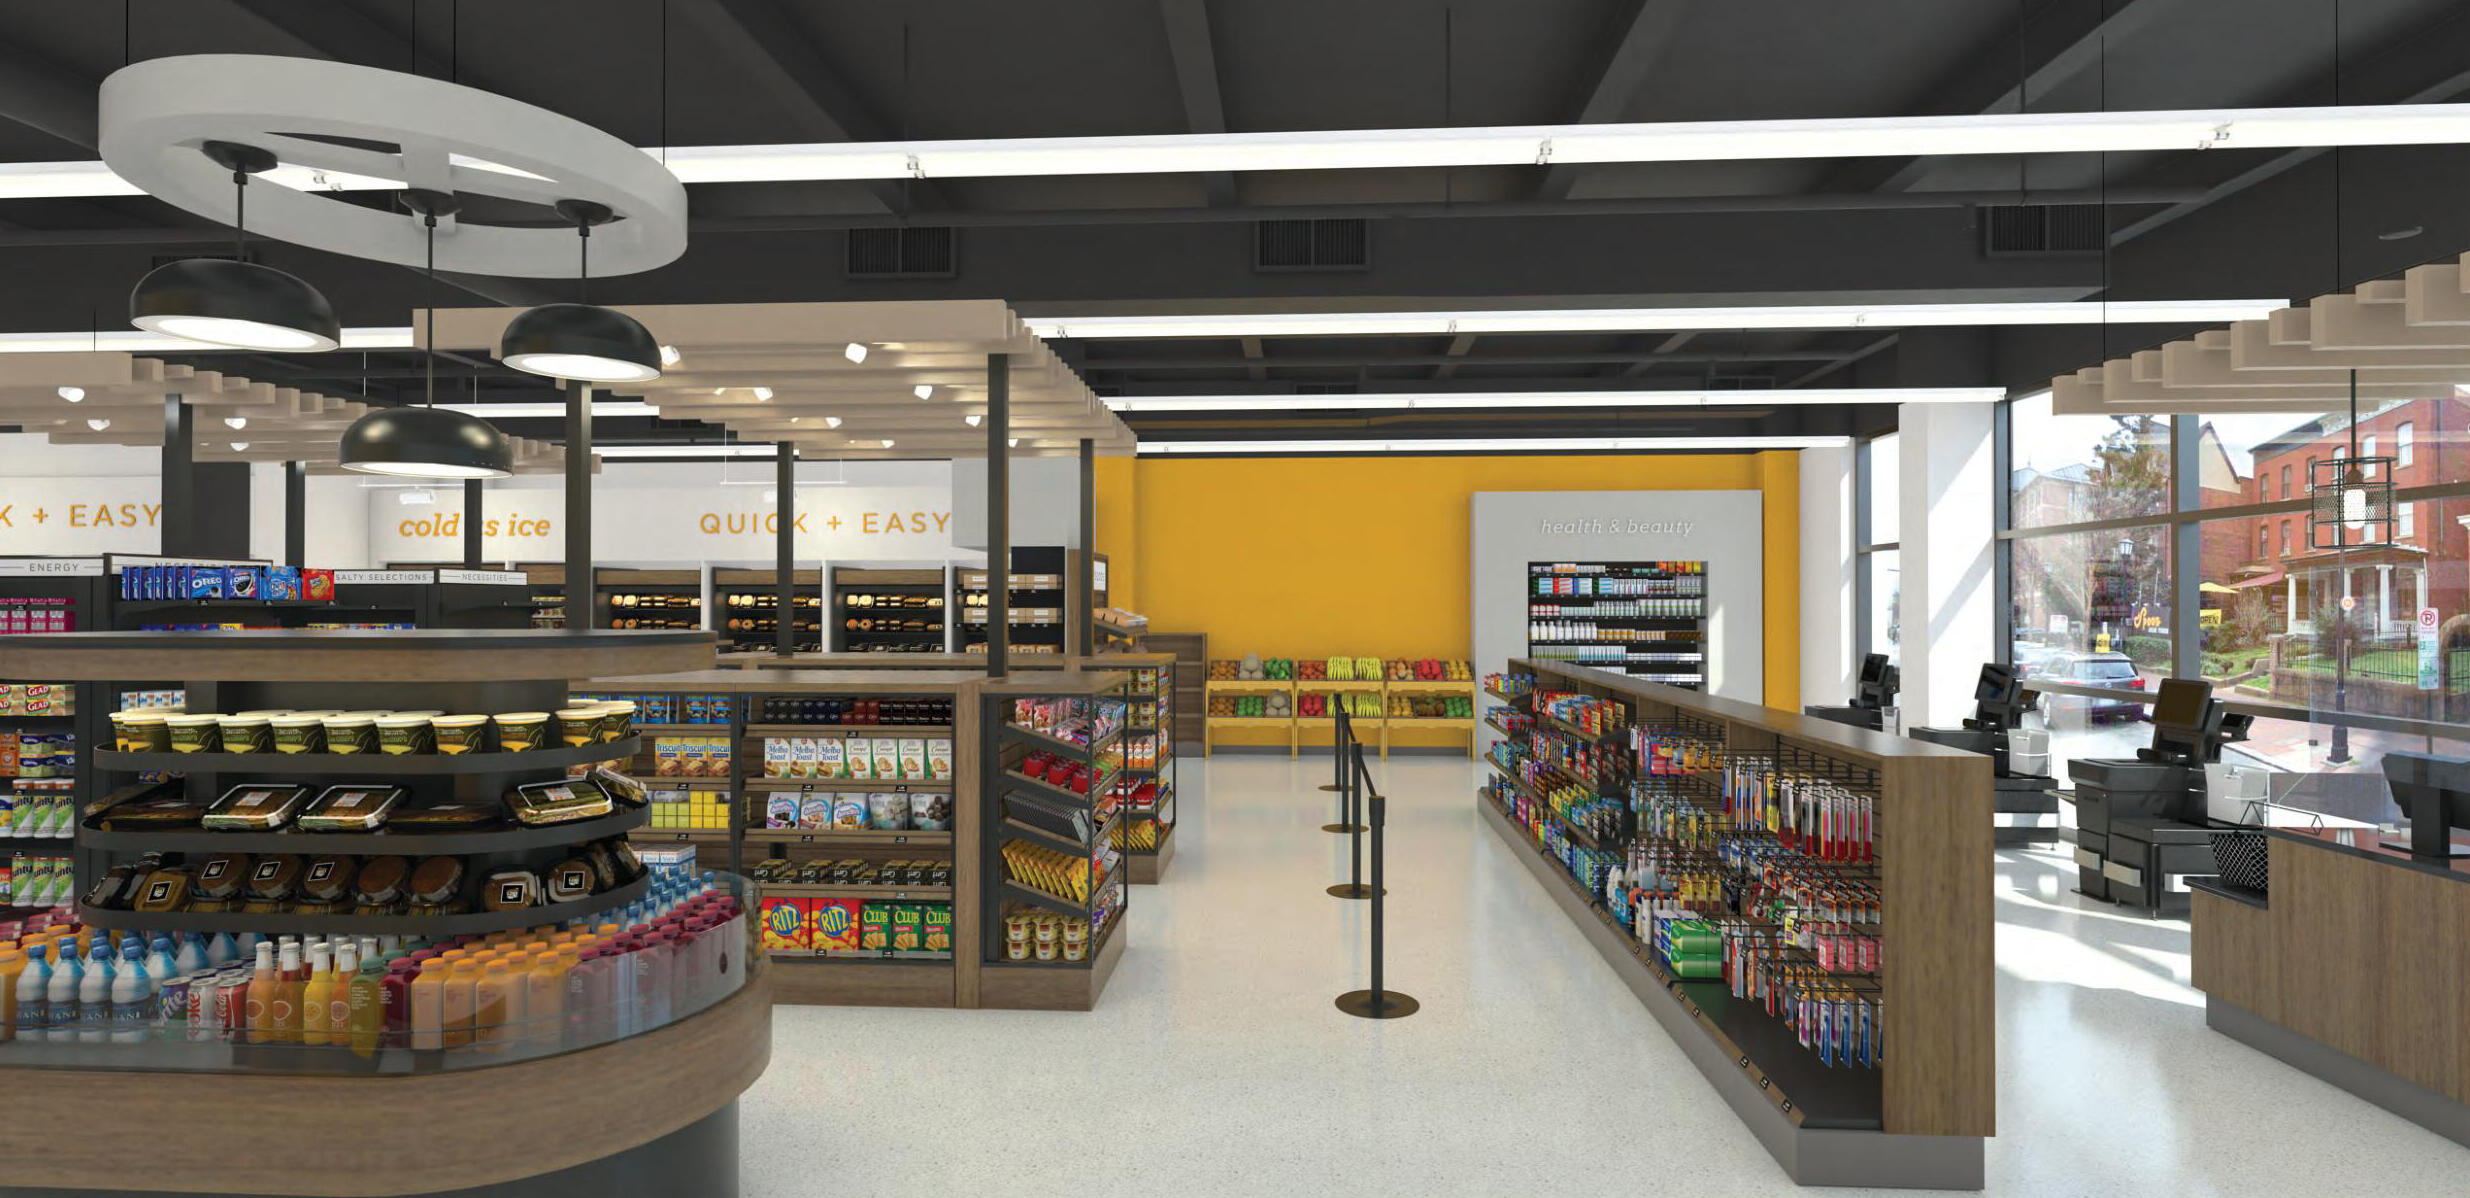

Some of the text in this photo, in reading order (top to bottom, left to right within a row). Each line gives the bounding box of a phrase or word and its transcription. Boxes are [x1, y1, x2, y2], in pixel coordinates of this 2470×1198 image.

[70, 504, 161, 527] EASY
[862, 511, 951, 534] EASY
[399, 512, 550, 537] cold s ice
[1541, 518, 1694, 537] health & beauty
[29, 562, 79, 573] ENERGY
[191, 576, 222, 588] OREO
[335, 573, 427, 581] SALTY SELECTIONS
[27, 685, 49, 697] GLAD
[27, 700, 49, 711] GLAD
[772, 907, 800, 932] RITZ
[821, 907, 848, 933] RITZ
[864, 910, 888, 923] CLUB
[895, 910, 920, 924] CLUB
[926, 910, 951, 924] CLUB
